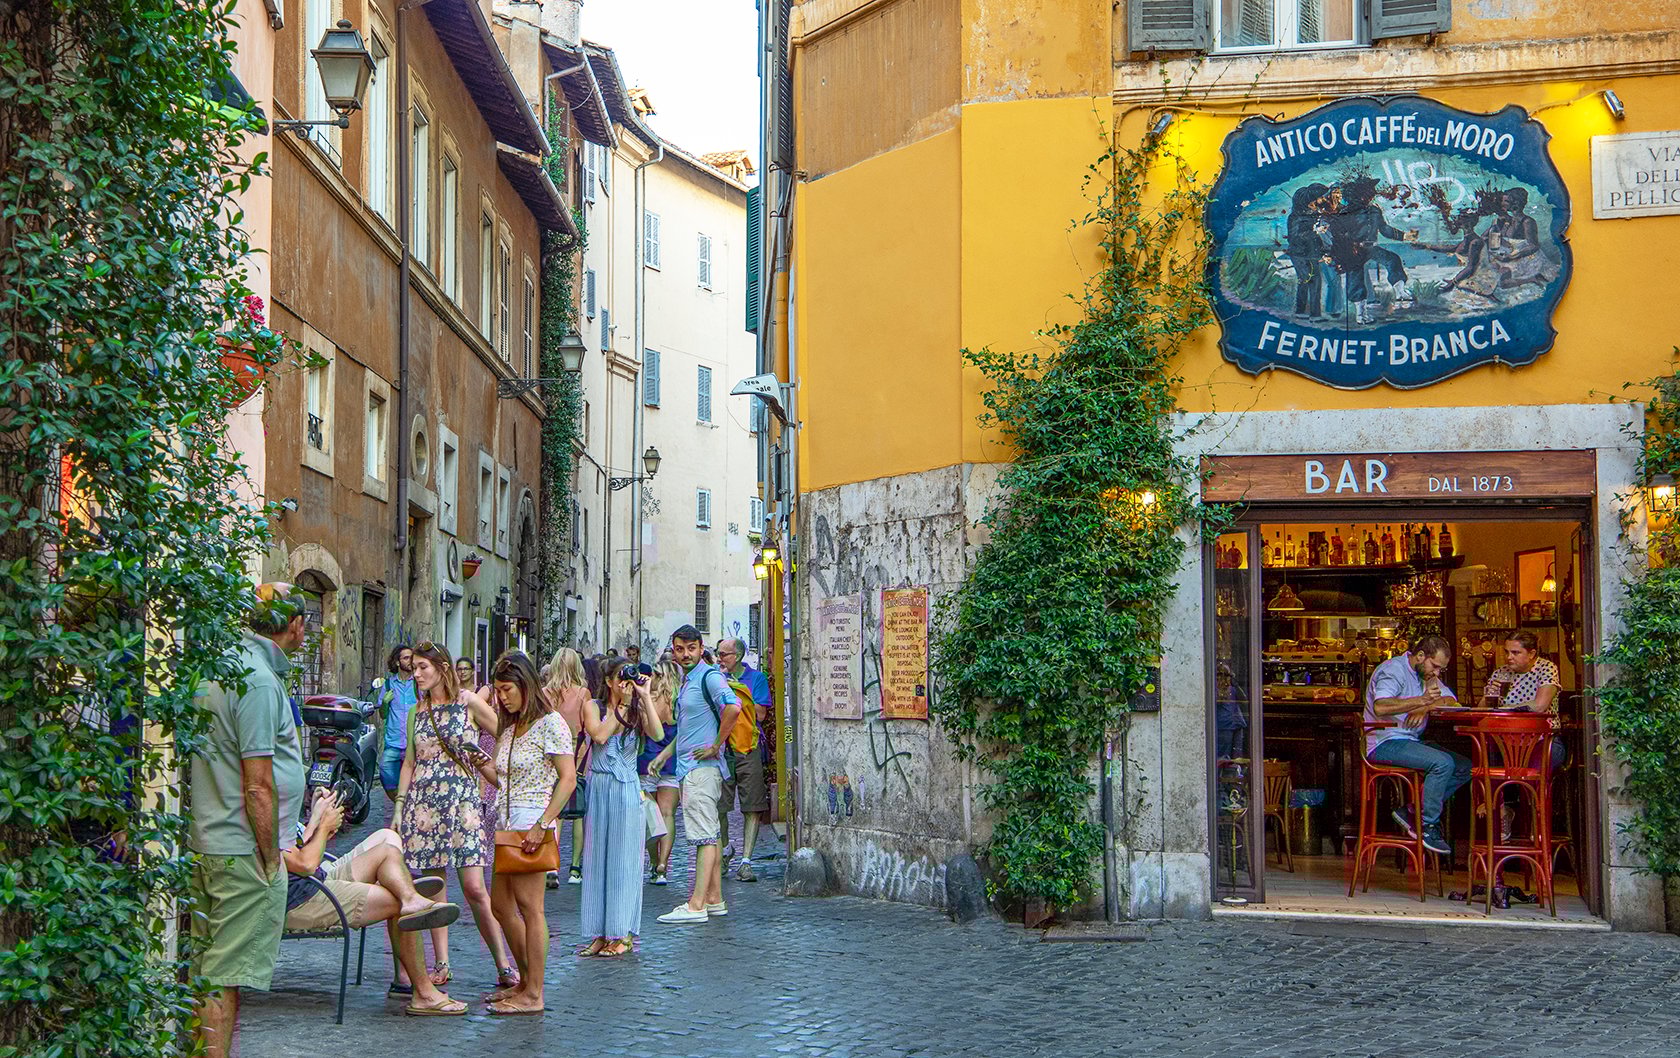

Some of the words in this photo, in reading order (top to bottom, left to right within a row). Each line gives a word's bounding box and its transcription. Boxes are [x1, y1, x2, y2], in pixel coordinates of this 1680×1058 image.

[1255, 120, 1337, 168] ANTICO
[1417, 126, 1442, 146] DEL
[1444, 120, 1515, 162] MORO
[1304, 458, 1389, 494] BAR
[1428, 476, 1462, 493] DAL
[1471, 475, 1514, 493] 1873
